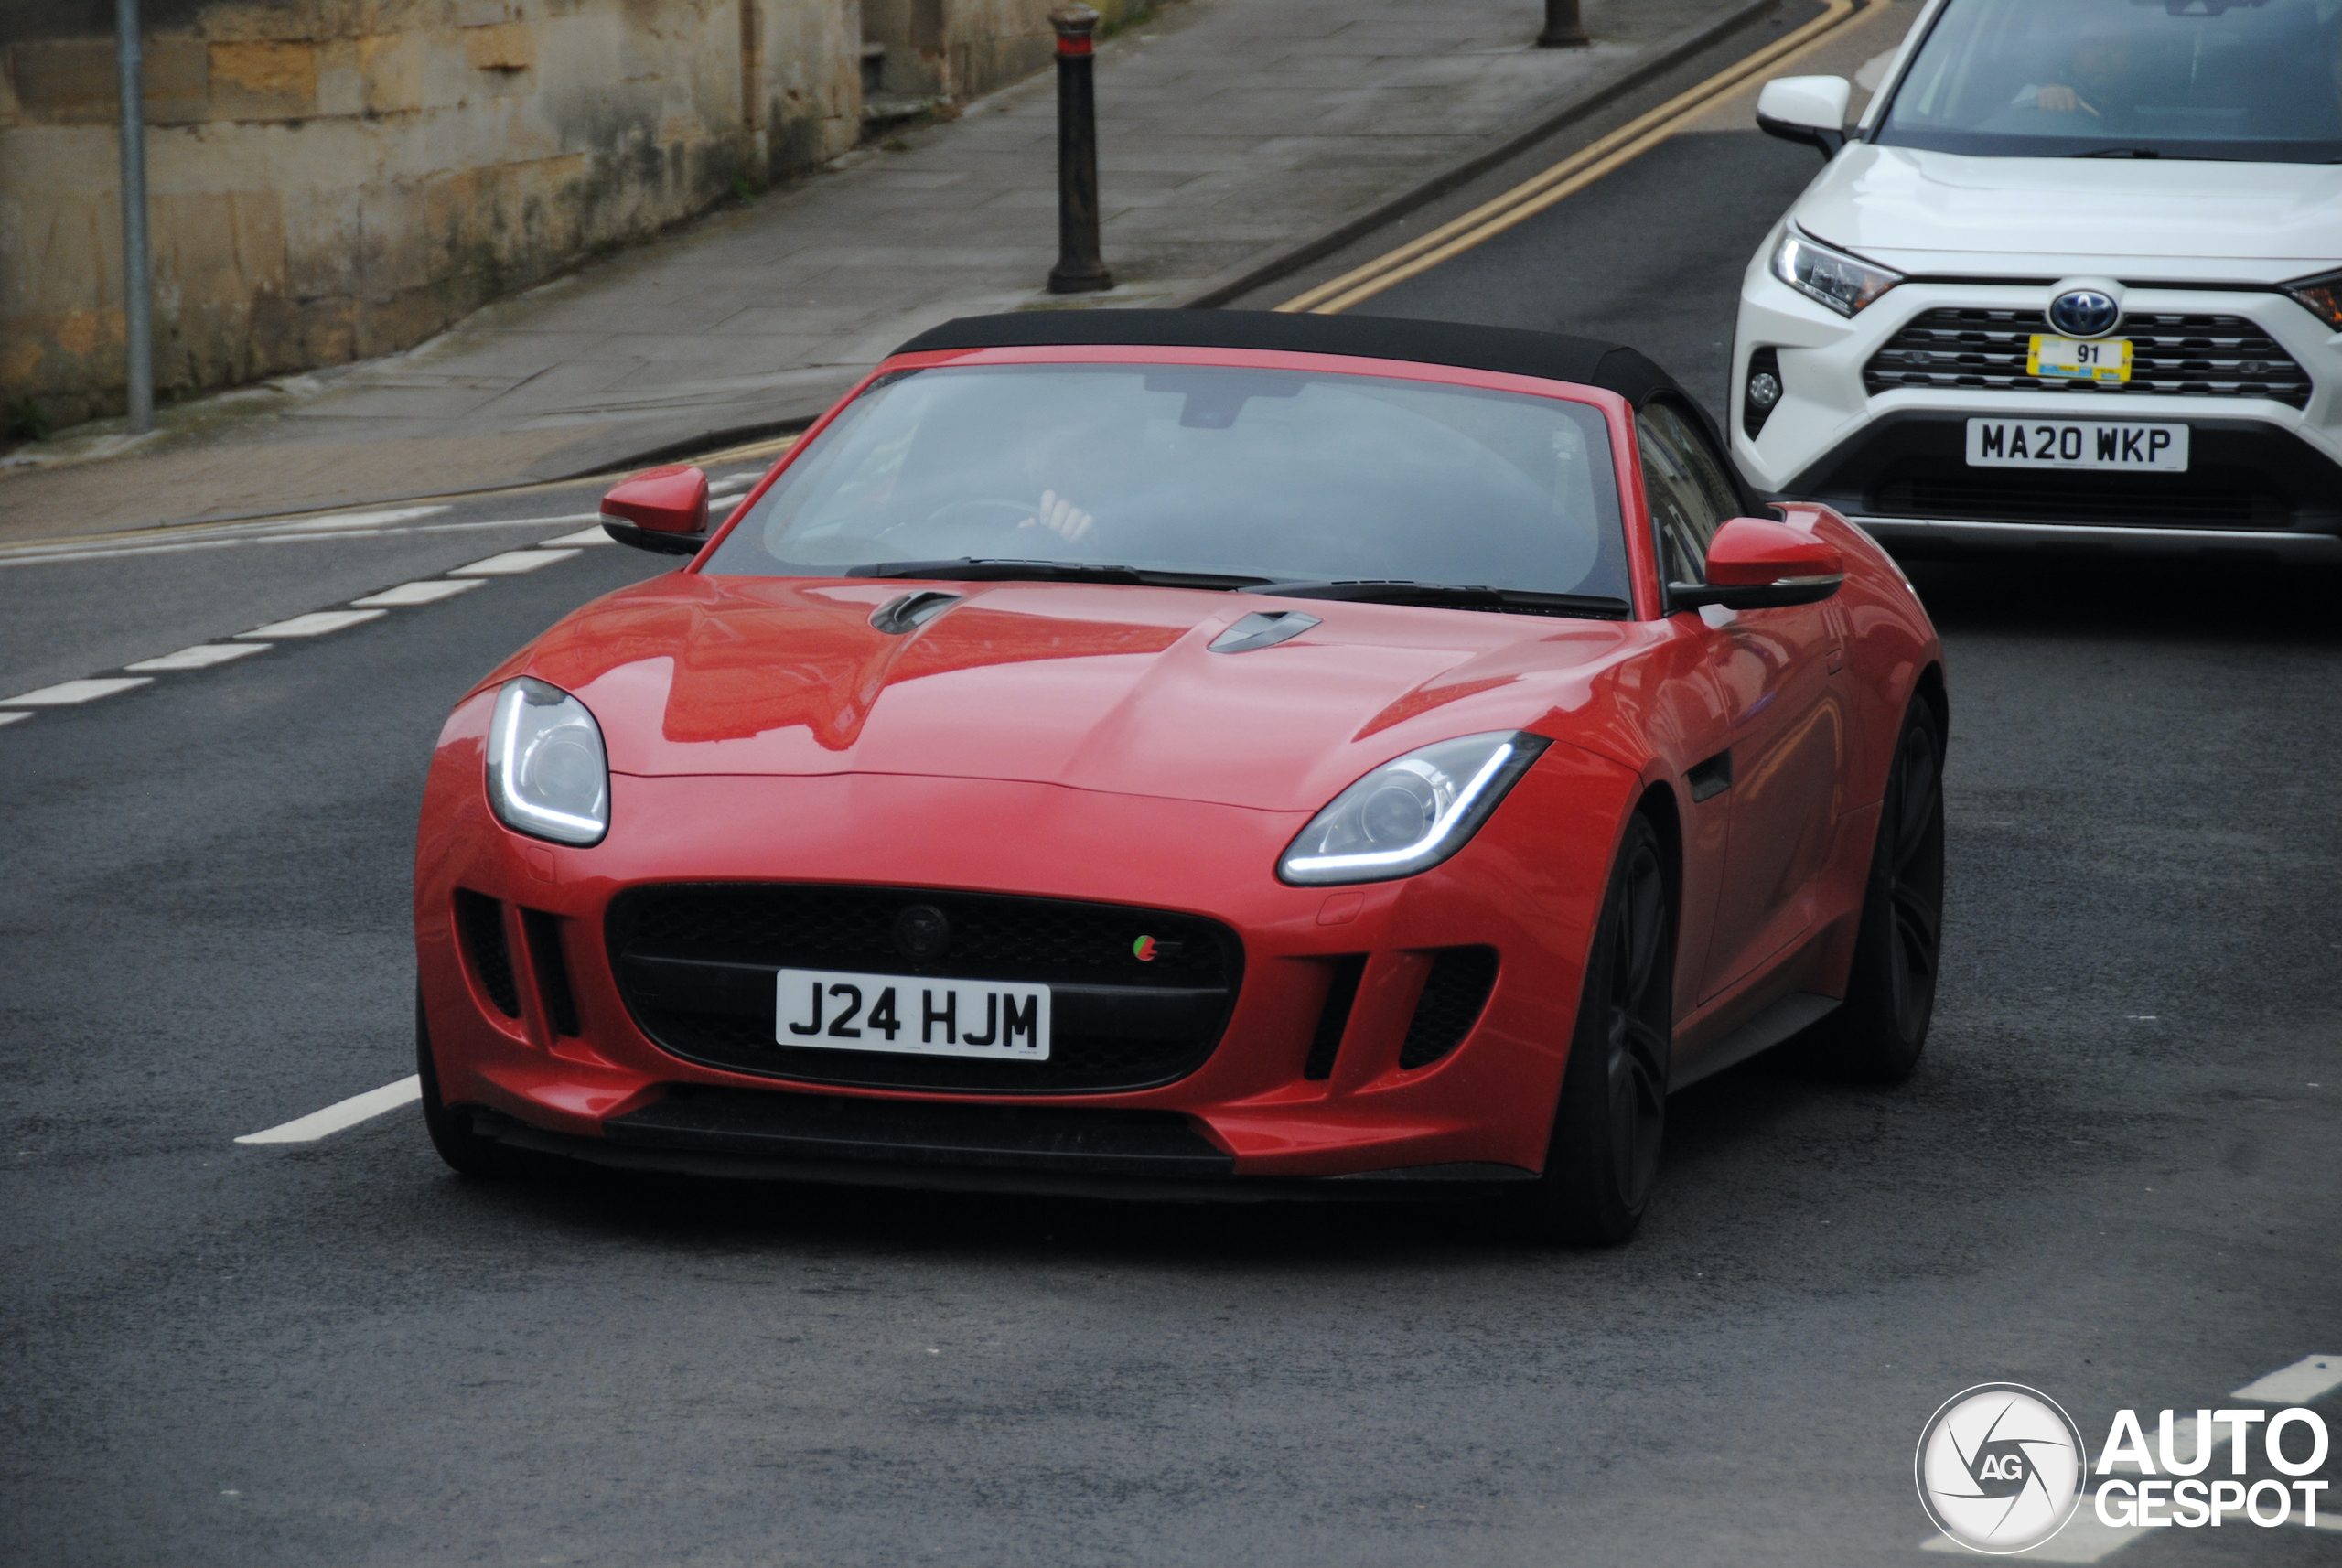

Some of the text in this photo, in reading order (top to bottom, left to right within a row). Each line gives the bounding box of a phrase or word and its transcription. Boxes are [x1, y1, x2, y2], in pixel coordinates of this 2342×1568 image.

[2077, 344, 2100, 364] 91
[1982, 424, 2171, 463] MA20 WKP
[788, 982, 1037, 1048] J24 HJM
